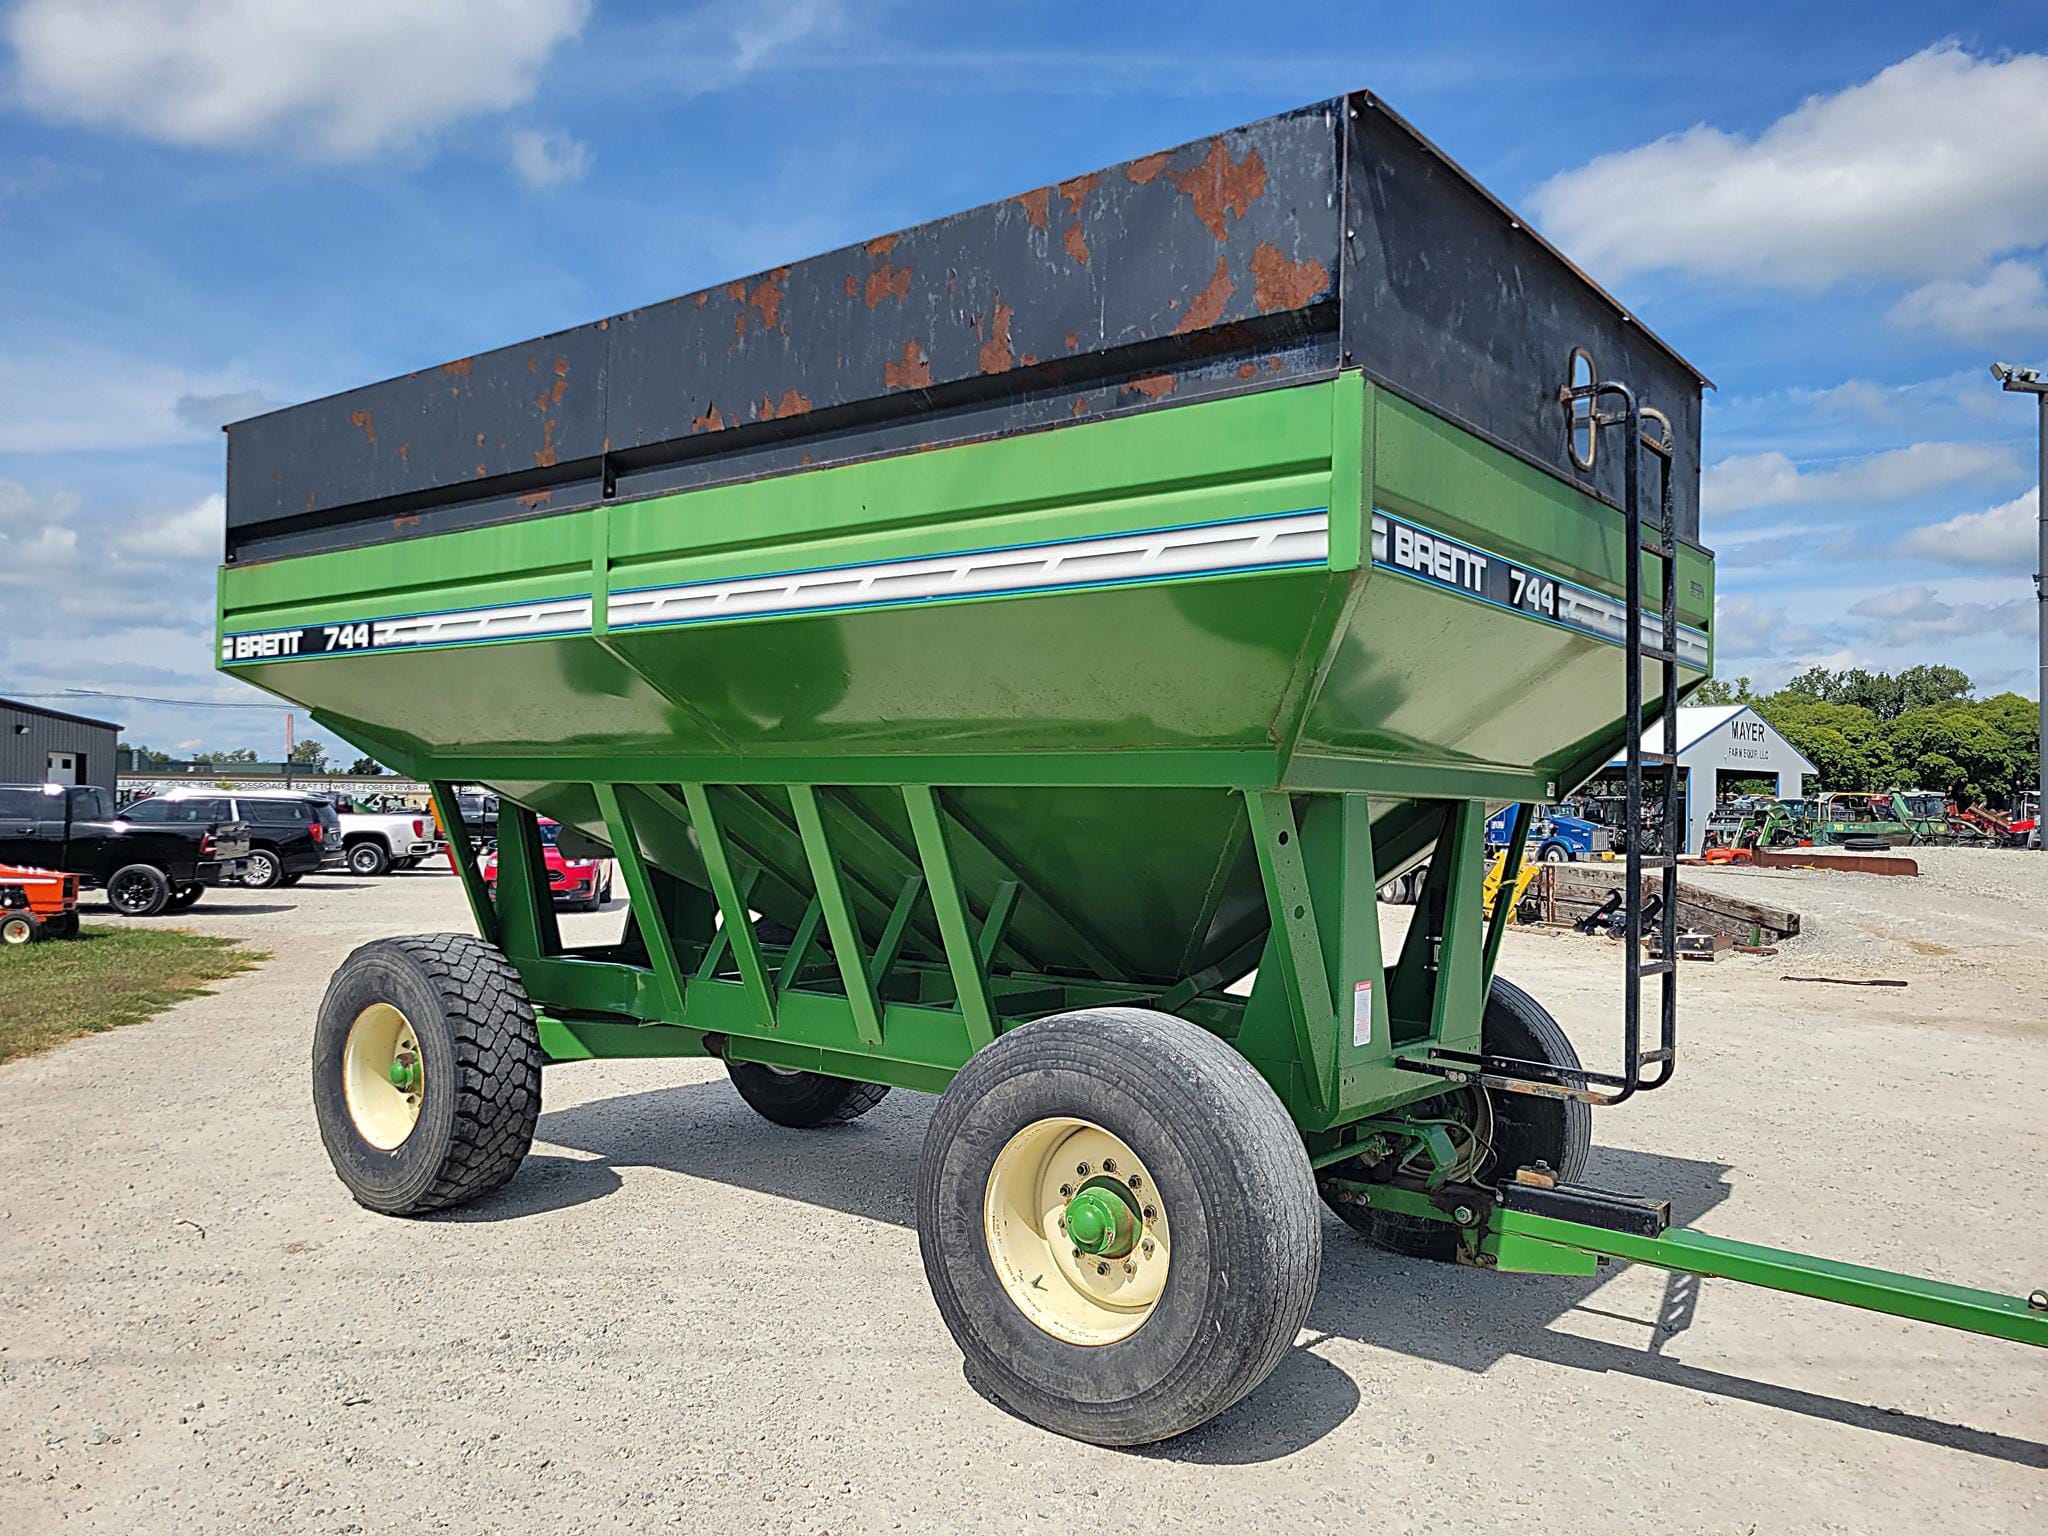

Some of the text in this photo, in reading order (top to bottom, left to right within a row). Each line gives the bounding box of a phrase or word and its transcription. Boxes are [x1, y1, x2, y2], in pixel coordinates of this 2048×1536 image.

[1394, 524, 1554, 616] BRENT 744
[235, 623, 369, 659] BRENT 744
[1731, 720, 1765, 743] MAYER
[1728, 747, 1743, 758] FARM
[1759, 750, 1769, 760] LLC
[332, 783, 356, 791] WEST
